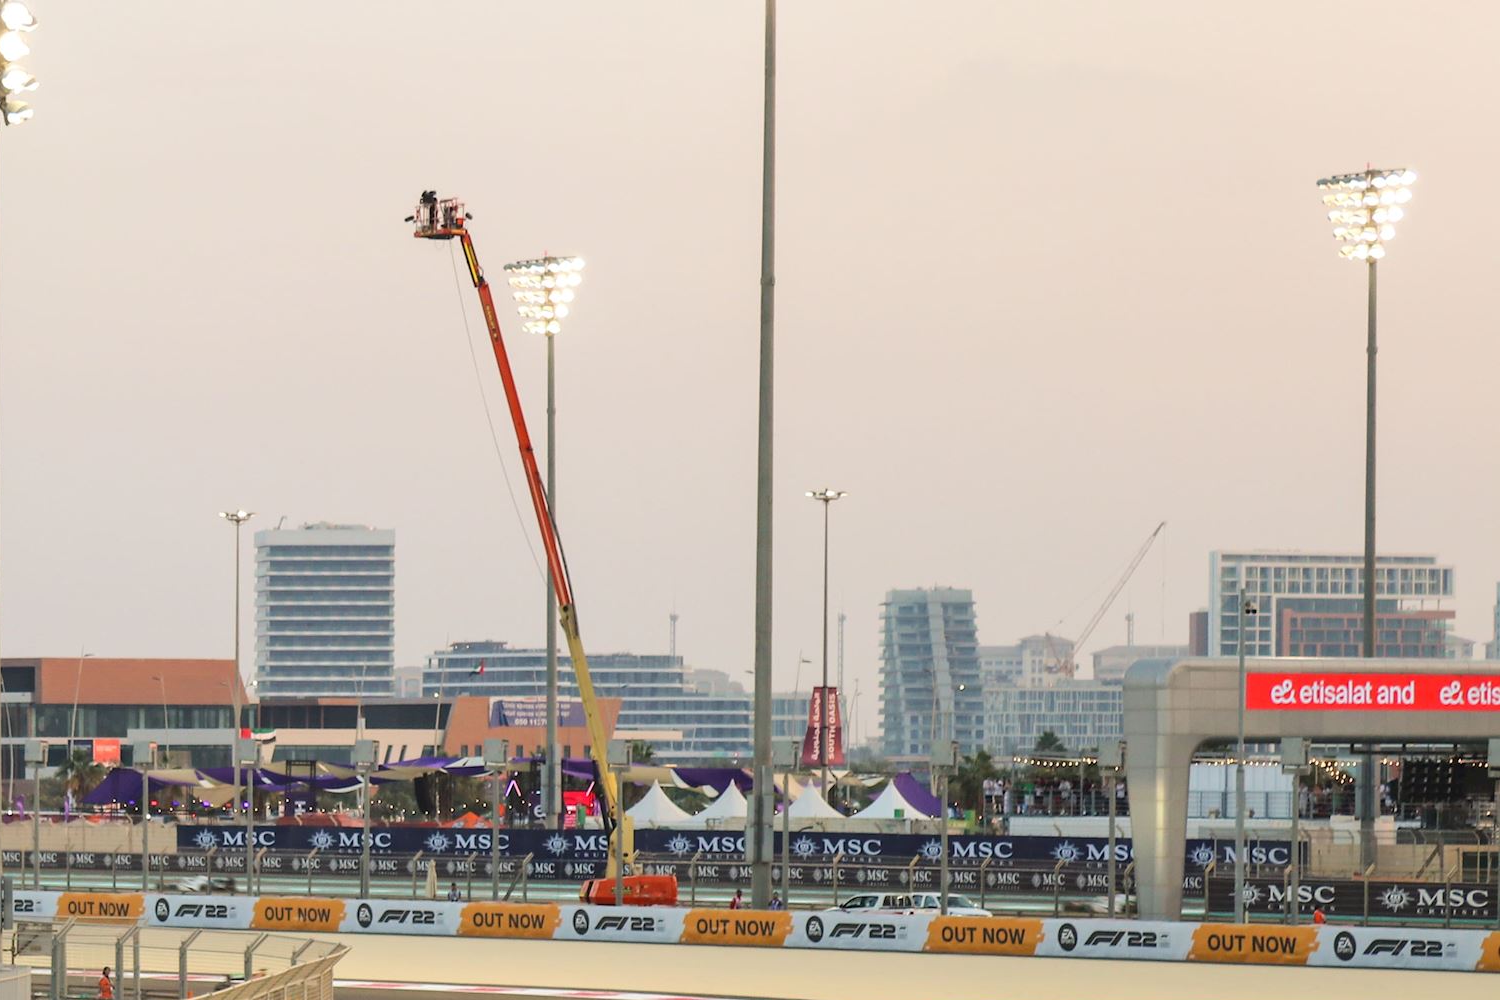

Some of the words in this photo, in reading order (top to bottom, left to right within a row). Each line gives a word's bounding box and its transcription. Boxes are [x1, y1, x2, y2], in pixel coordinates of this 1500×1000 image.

[1271, 679, 1296, 705] e&
[1300, 680, 1372, 705] etisalat
[1377, 680, 1415, 705] and
[1440, 681, 1464, 706] e&
[1467, 681, 1500, 706] etis
[828, 693, 836, 724] OASIS
[828, 725, 836, 760] SOUTH
[575, 835, 608, 850] MS
[822, 838, 882, 855] MSC
[952, 841, 1013, 859] MSC
[1086, 844, 1134, 862] MS
[76, 854, 95, 864] MSC
[187, 856, 207, 866] MSC
[225, 856, 244, 867] MSC
[262, 857, 281, 867] MSC
[339, 858, 358, 869] MSC
[378, 860, 397, 870] MSC
[417, 860, 429, 870] MS
[535, 863, 555, 873] MSC
[574, 863, 595, 874] MSC
[698, 866, 719, 877] MSC
[739, 867, 752, 877] MS
[823, 869, 845, 879] MC
[867, 870, 889, 881] MSC
[954, 872, 976, 882] MSC
[997, 873, 1020, 884] MSC
[1417, 888, 1488, 907] MSC
[14, 899, 34, 912] 22
[68, 901, 94, 915] OUT
[98, 903, 129, 917] NOW
[205, 905, 227, 918] 22
[264, 905, 293, 921] OUT
[297, 907, 331, 922] NOW
[412, 910, 435, 924] 22
[473, 911, 503, 927] OUT
[508, 914, 545, 929] NOW
[631, 917, 655, 931] 22
[697, 918, 730, 934] OUT
[735, 920, 775, 936] NOW
[869, 924, 896, 939] 22
[942, 926, 977, 943] OUT
[982, 927, 1025, 945] NOW
[1061, 928, 1074, 938] EA
[1127, 931, 1157, 947] 22
[1207, 933, 1245, 952] OUT
[1252, 935, 1297, 953] NOW
[1338, 936, 1353, 948] EA
[1410, 940, 1443, 957] 22
